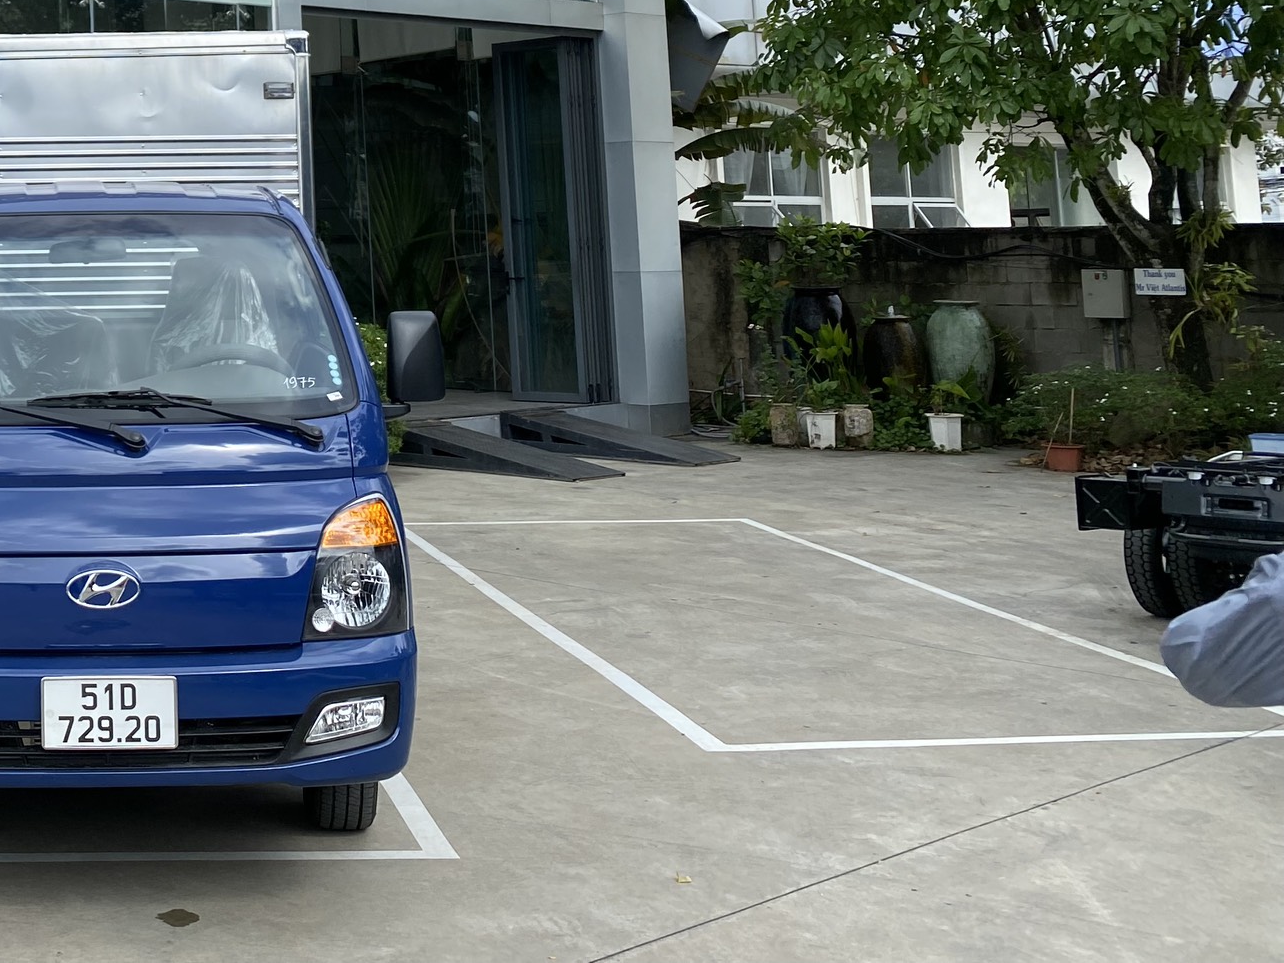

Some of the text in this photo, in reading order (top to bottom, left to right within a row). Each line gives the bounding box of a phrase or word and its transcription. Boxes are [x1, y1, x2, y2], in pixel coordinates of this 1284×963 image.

[283, 375, 316, 389] 1975
[81, 682, 137, 711] 51D
[58, 715, 161, 743] 729.20
